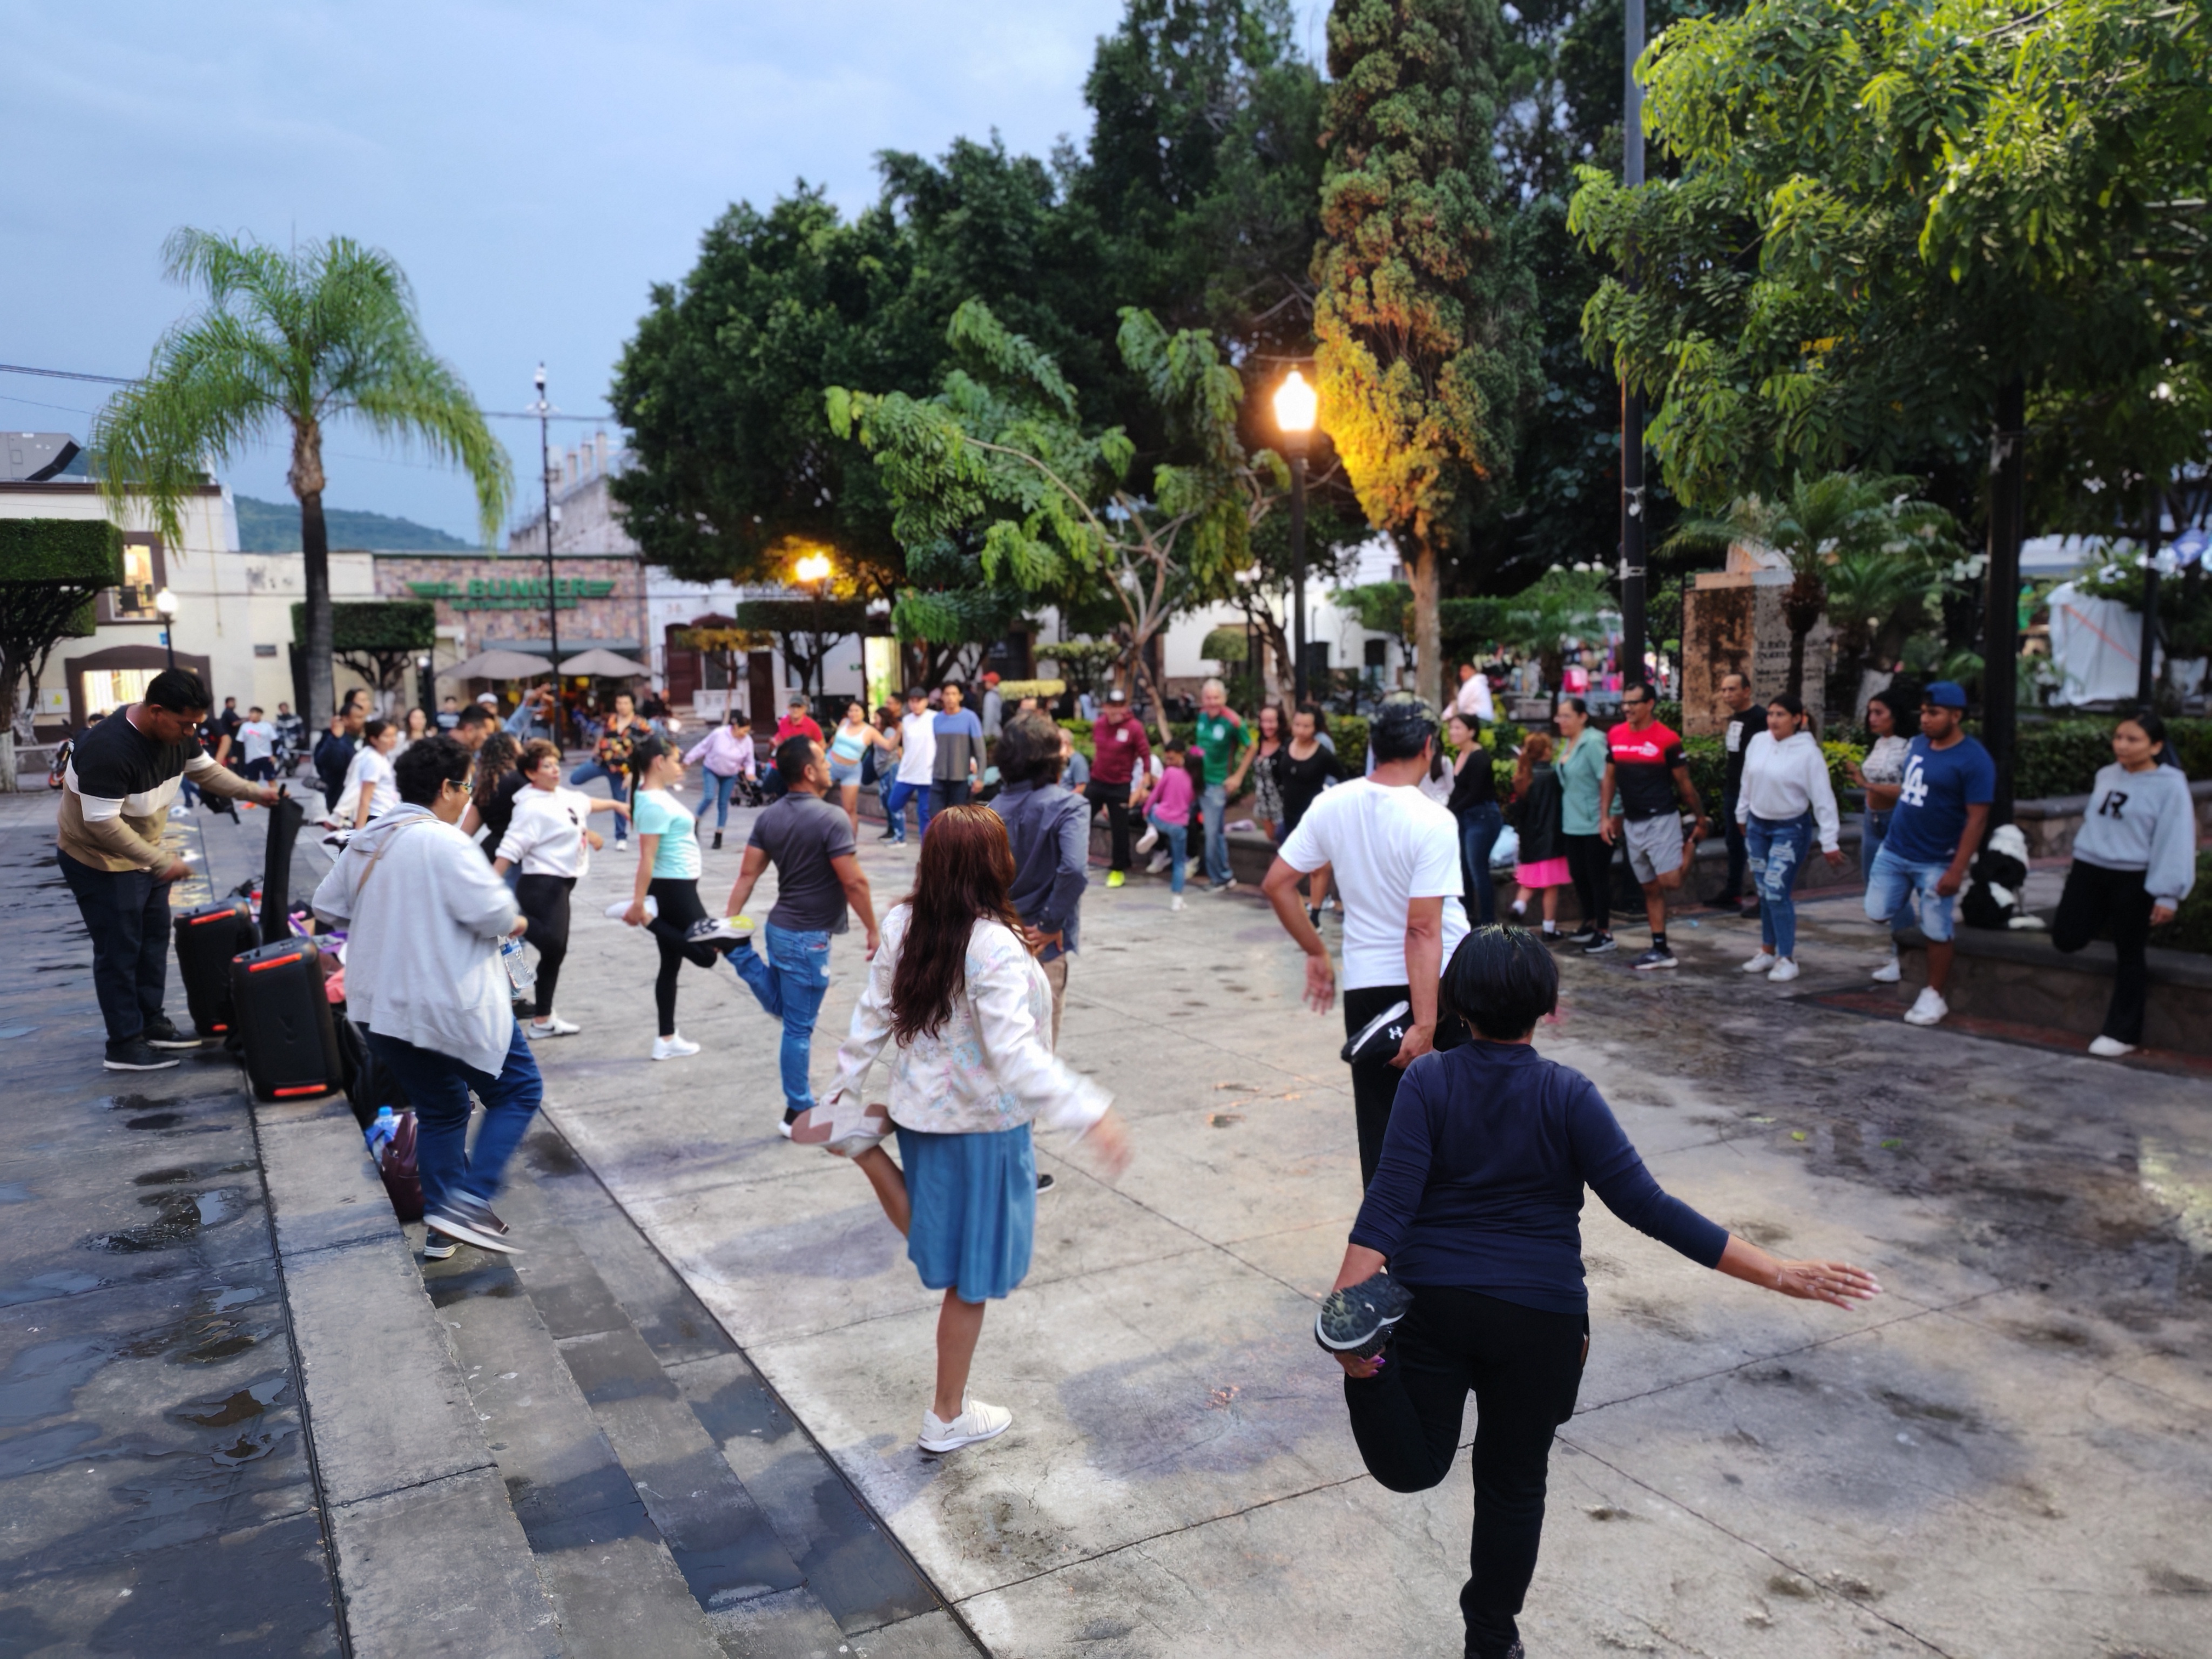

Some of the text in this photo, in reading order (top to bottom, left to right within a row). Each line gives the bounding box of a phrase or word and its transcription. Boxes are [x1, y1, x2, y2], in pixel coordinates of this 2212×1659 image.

[468, 578, 588, 597] BUNKER
[1900, 754, 1928, 807] LA
[2099, 790, 2128, 820] R
